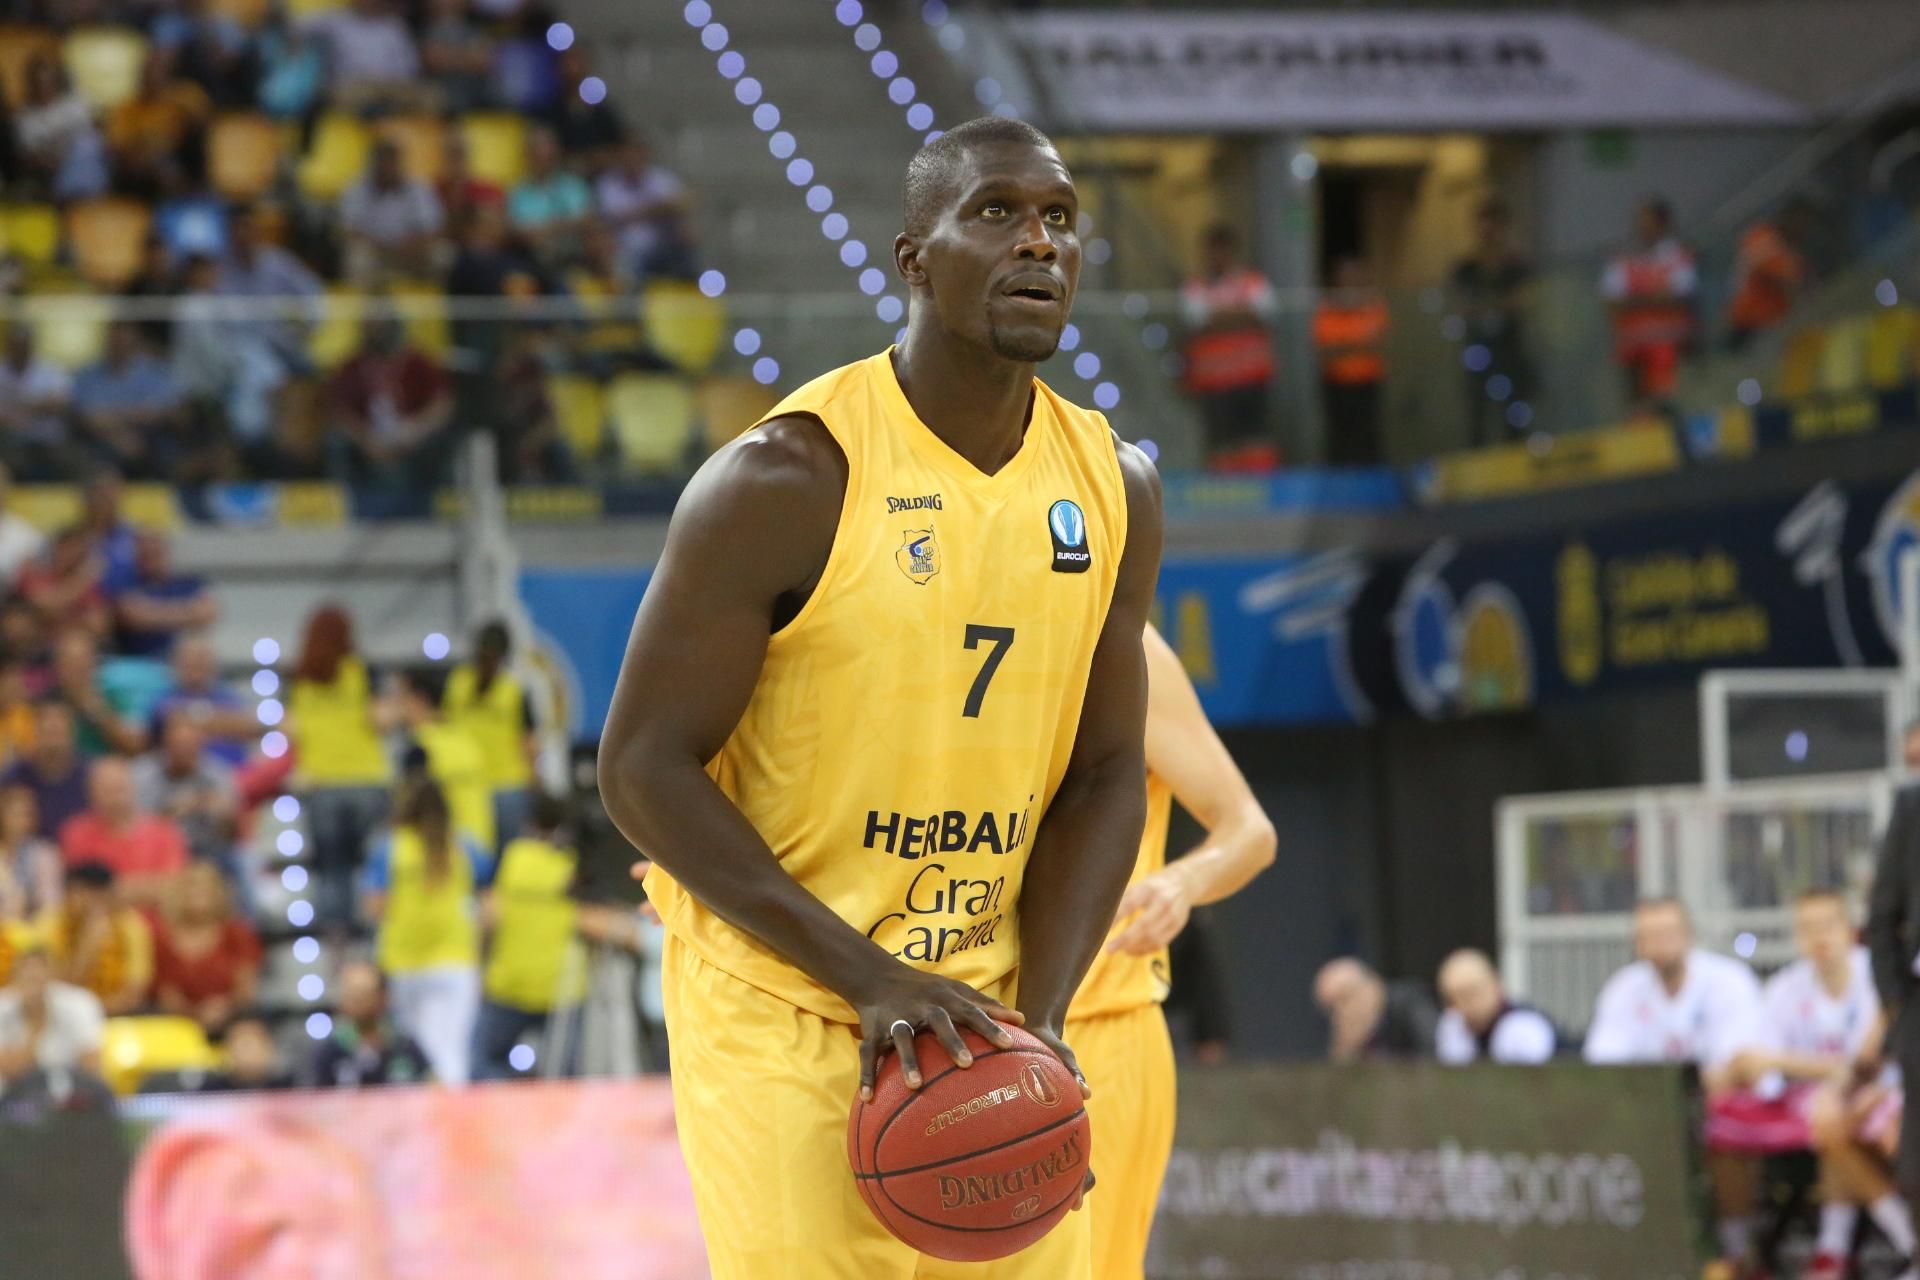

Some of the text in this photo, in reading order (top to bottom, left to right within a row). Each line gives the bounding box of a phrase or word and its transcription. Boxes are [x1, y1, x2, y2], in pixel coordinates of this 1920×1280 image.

[1056, 551, 1090, 561] EUROCUP
[963, 624, 1015, 718] 7
[905, 863, 1005, 916] Gran
[926, 1083, 1021, 1136] EUROCUP
[939, 1127, 1082, 1209] SPALDING
